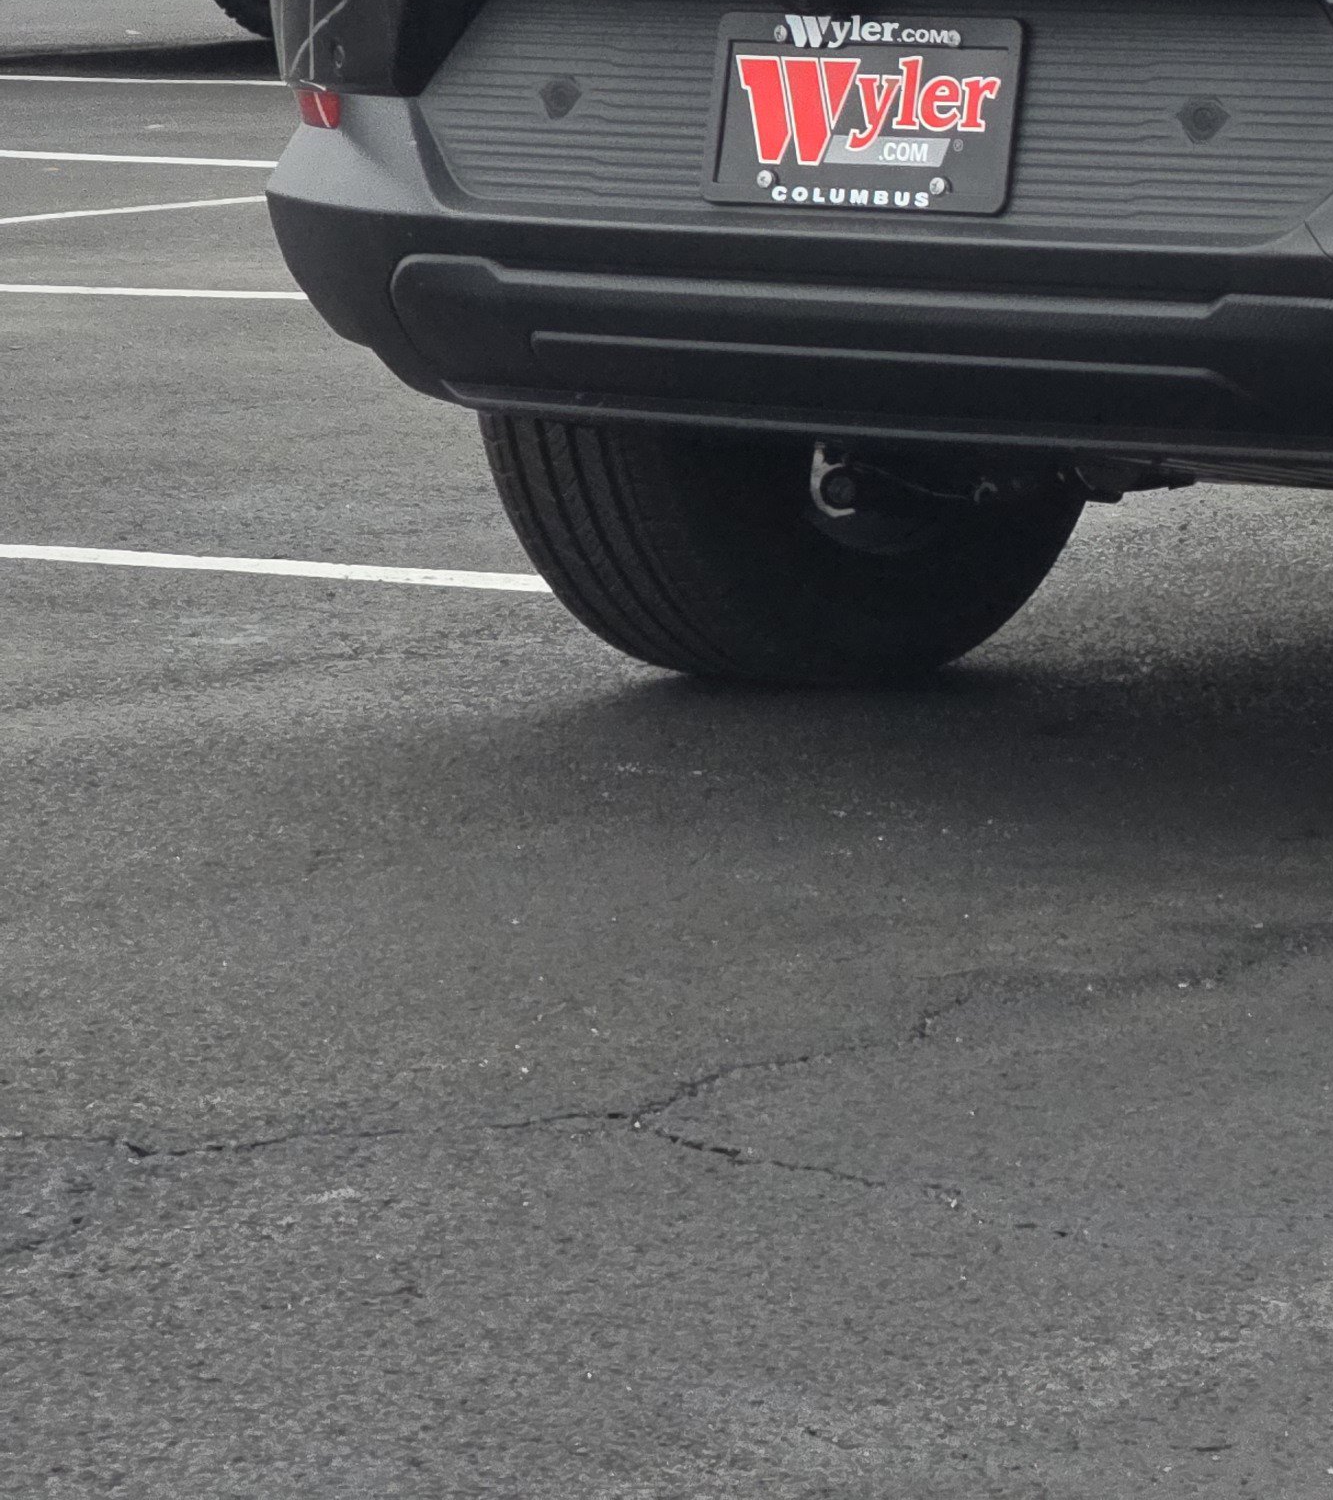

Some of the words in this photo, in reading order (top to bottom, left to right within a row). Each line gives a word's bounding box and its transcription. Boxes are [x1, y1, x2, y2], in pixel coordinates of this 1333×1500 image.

[736, 55, 1001, 166] Wyler
[878, 142, 929, 162] .COM
[771, 186, 930, 207] COLUMBUS
